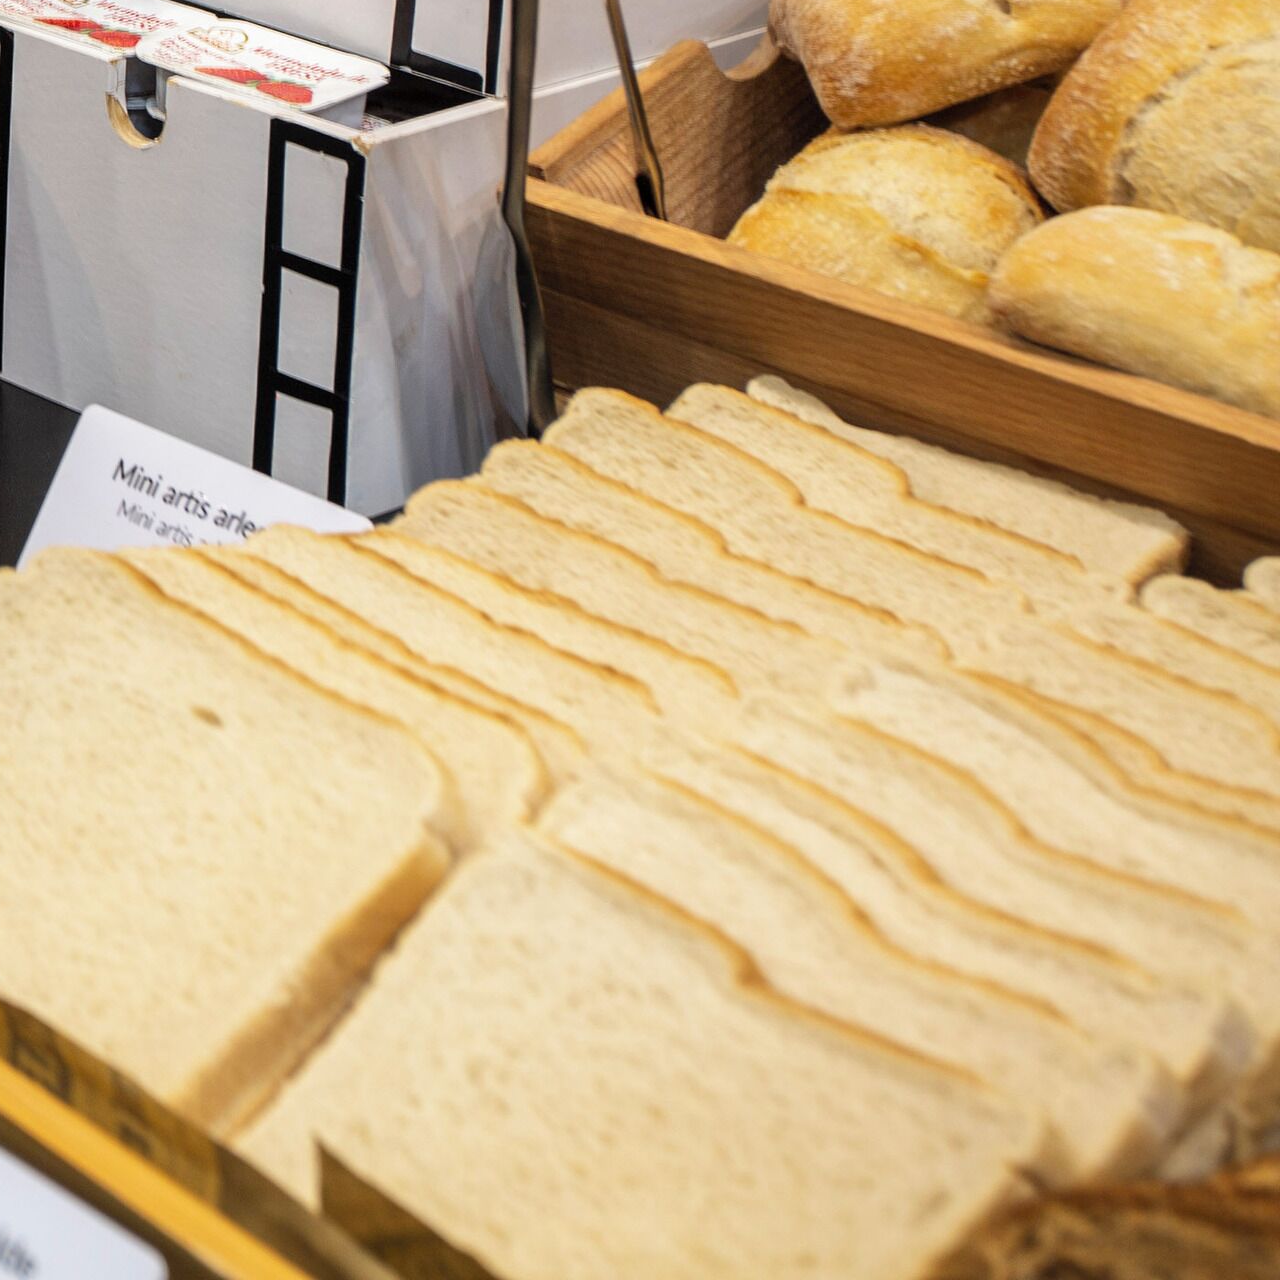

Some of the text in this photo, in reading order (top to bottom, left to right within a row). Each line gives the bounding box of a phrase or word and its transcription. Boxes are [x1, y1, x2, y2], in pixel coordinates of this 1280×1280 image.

[111, 457, 163, 498] Mini
[162, 486, 211, 520] artis
[116, 498, 156, 531] Mini
